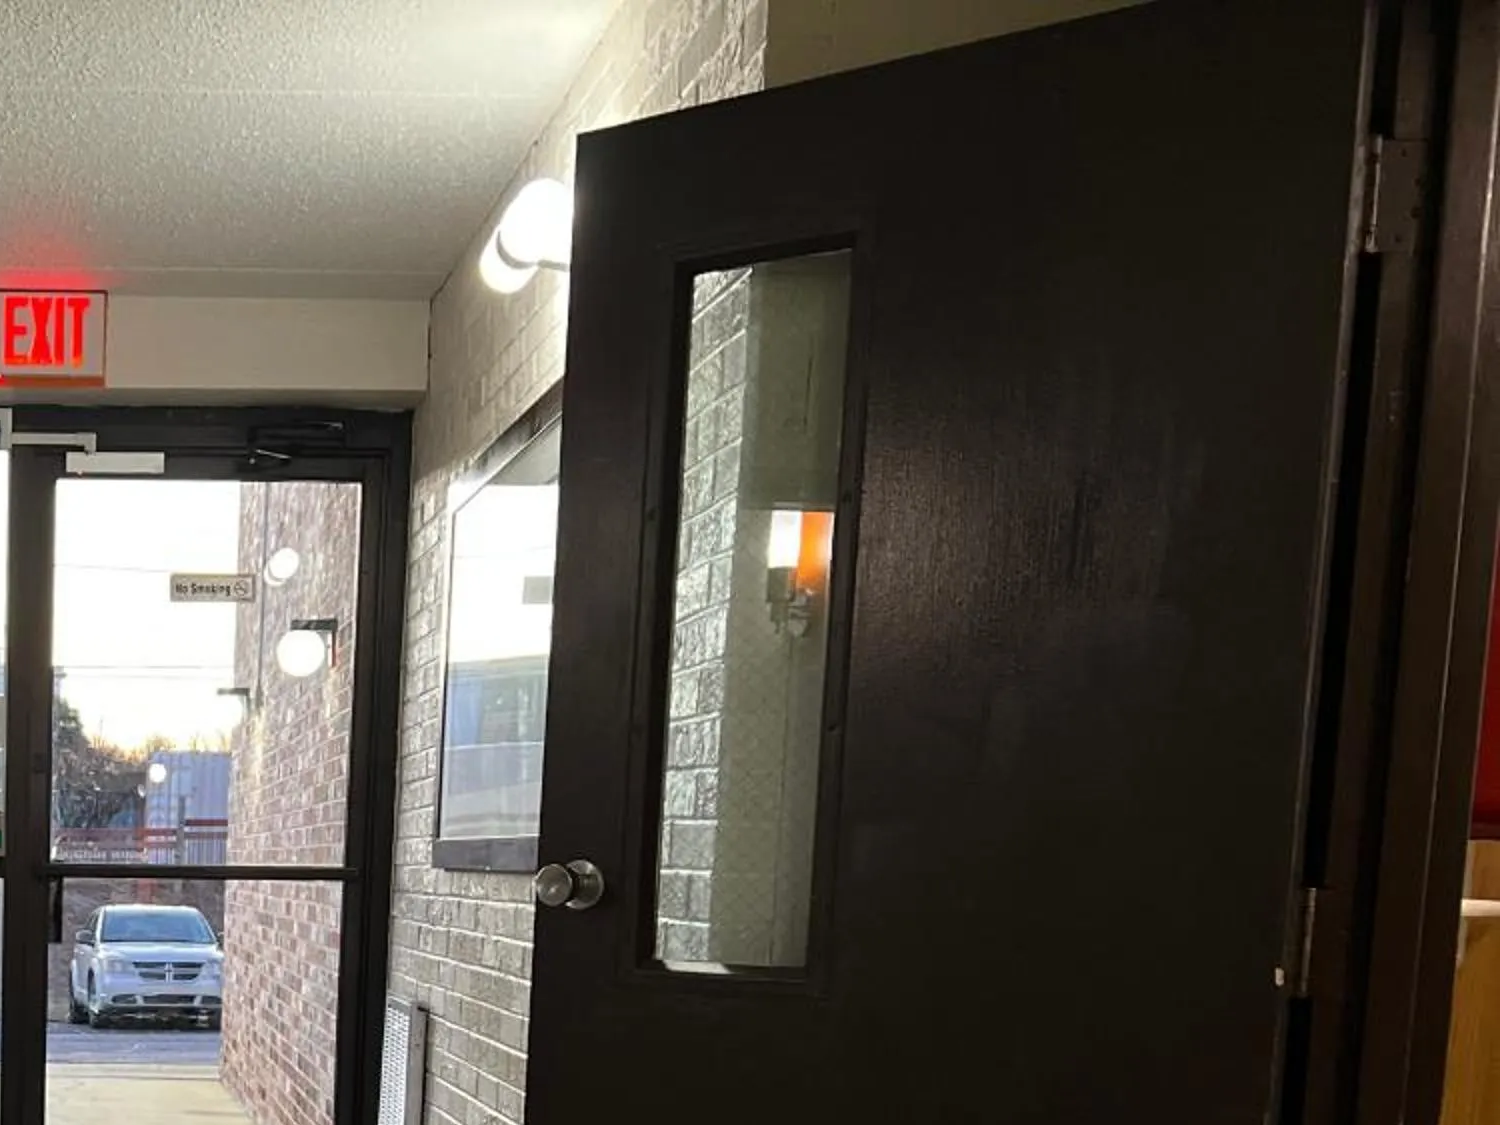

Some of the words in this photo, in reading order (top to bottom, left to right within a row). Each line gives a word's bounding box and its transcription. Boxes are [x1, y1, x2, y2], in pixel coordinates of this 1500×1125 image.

[4, 297, 90, 367] EXIT
[175, 582, 189, 594] No
[191, 582, 231, 597] Smoking
